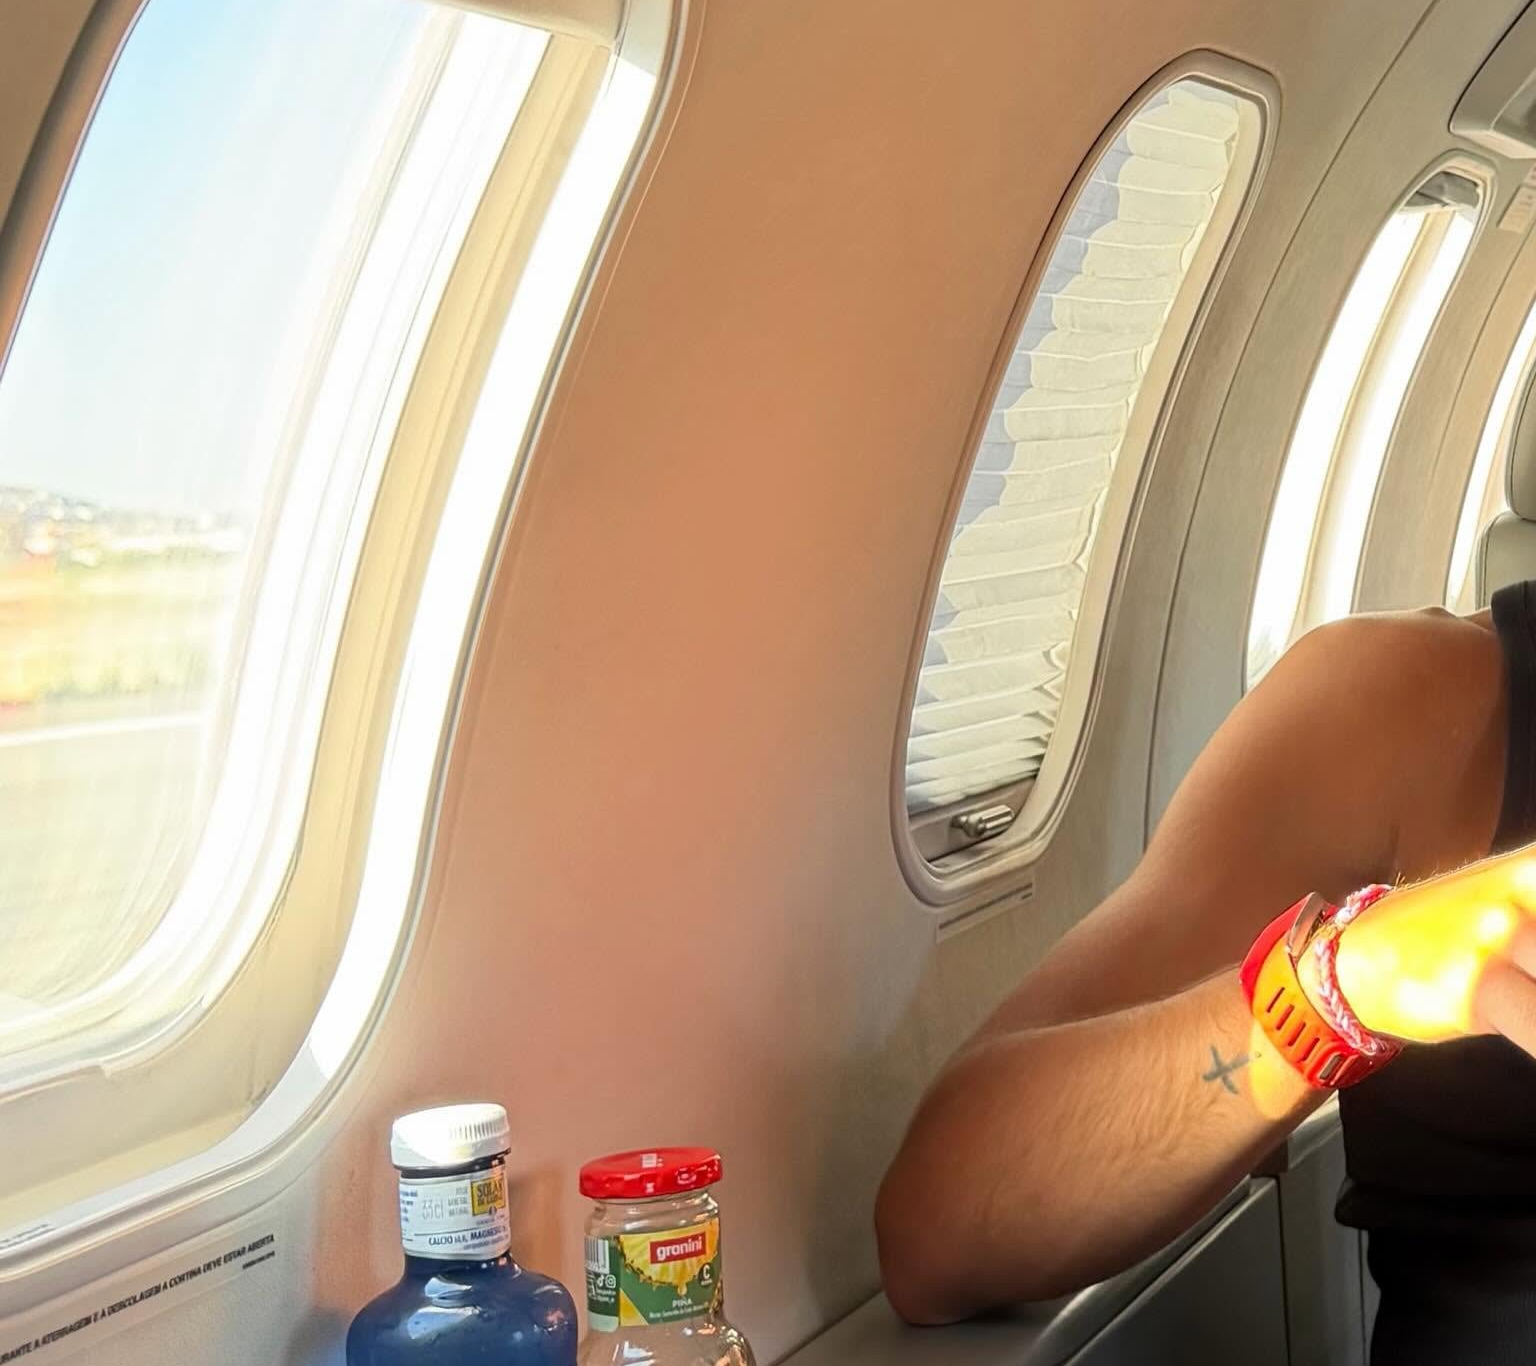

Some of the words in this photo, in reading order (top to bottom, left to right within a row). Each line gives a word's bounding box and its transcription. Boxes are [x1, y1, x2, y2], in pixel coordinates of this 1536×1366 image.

[422, 1198, 444, 1220] 33cl
[656, 1236, 702, 1261] granini
[33, 1339, 40, 1350] A
[100, 1308, 106, 1320] A
[107, 1283, 161, 1316] DESCOLAGEM
[162, 1281, 168, 1292] A
[169, 1266, 201, 1289] CORTINA
[202, 1257, 222, 1274] DEVE
[223, 1246, 246, 1265] ESTAR
[247, 1234, 275, 1253] ABERTA
